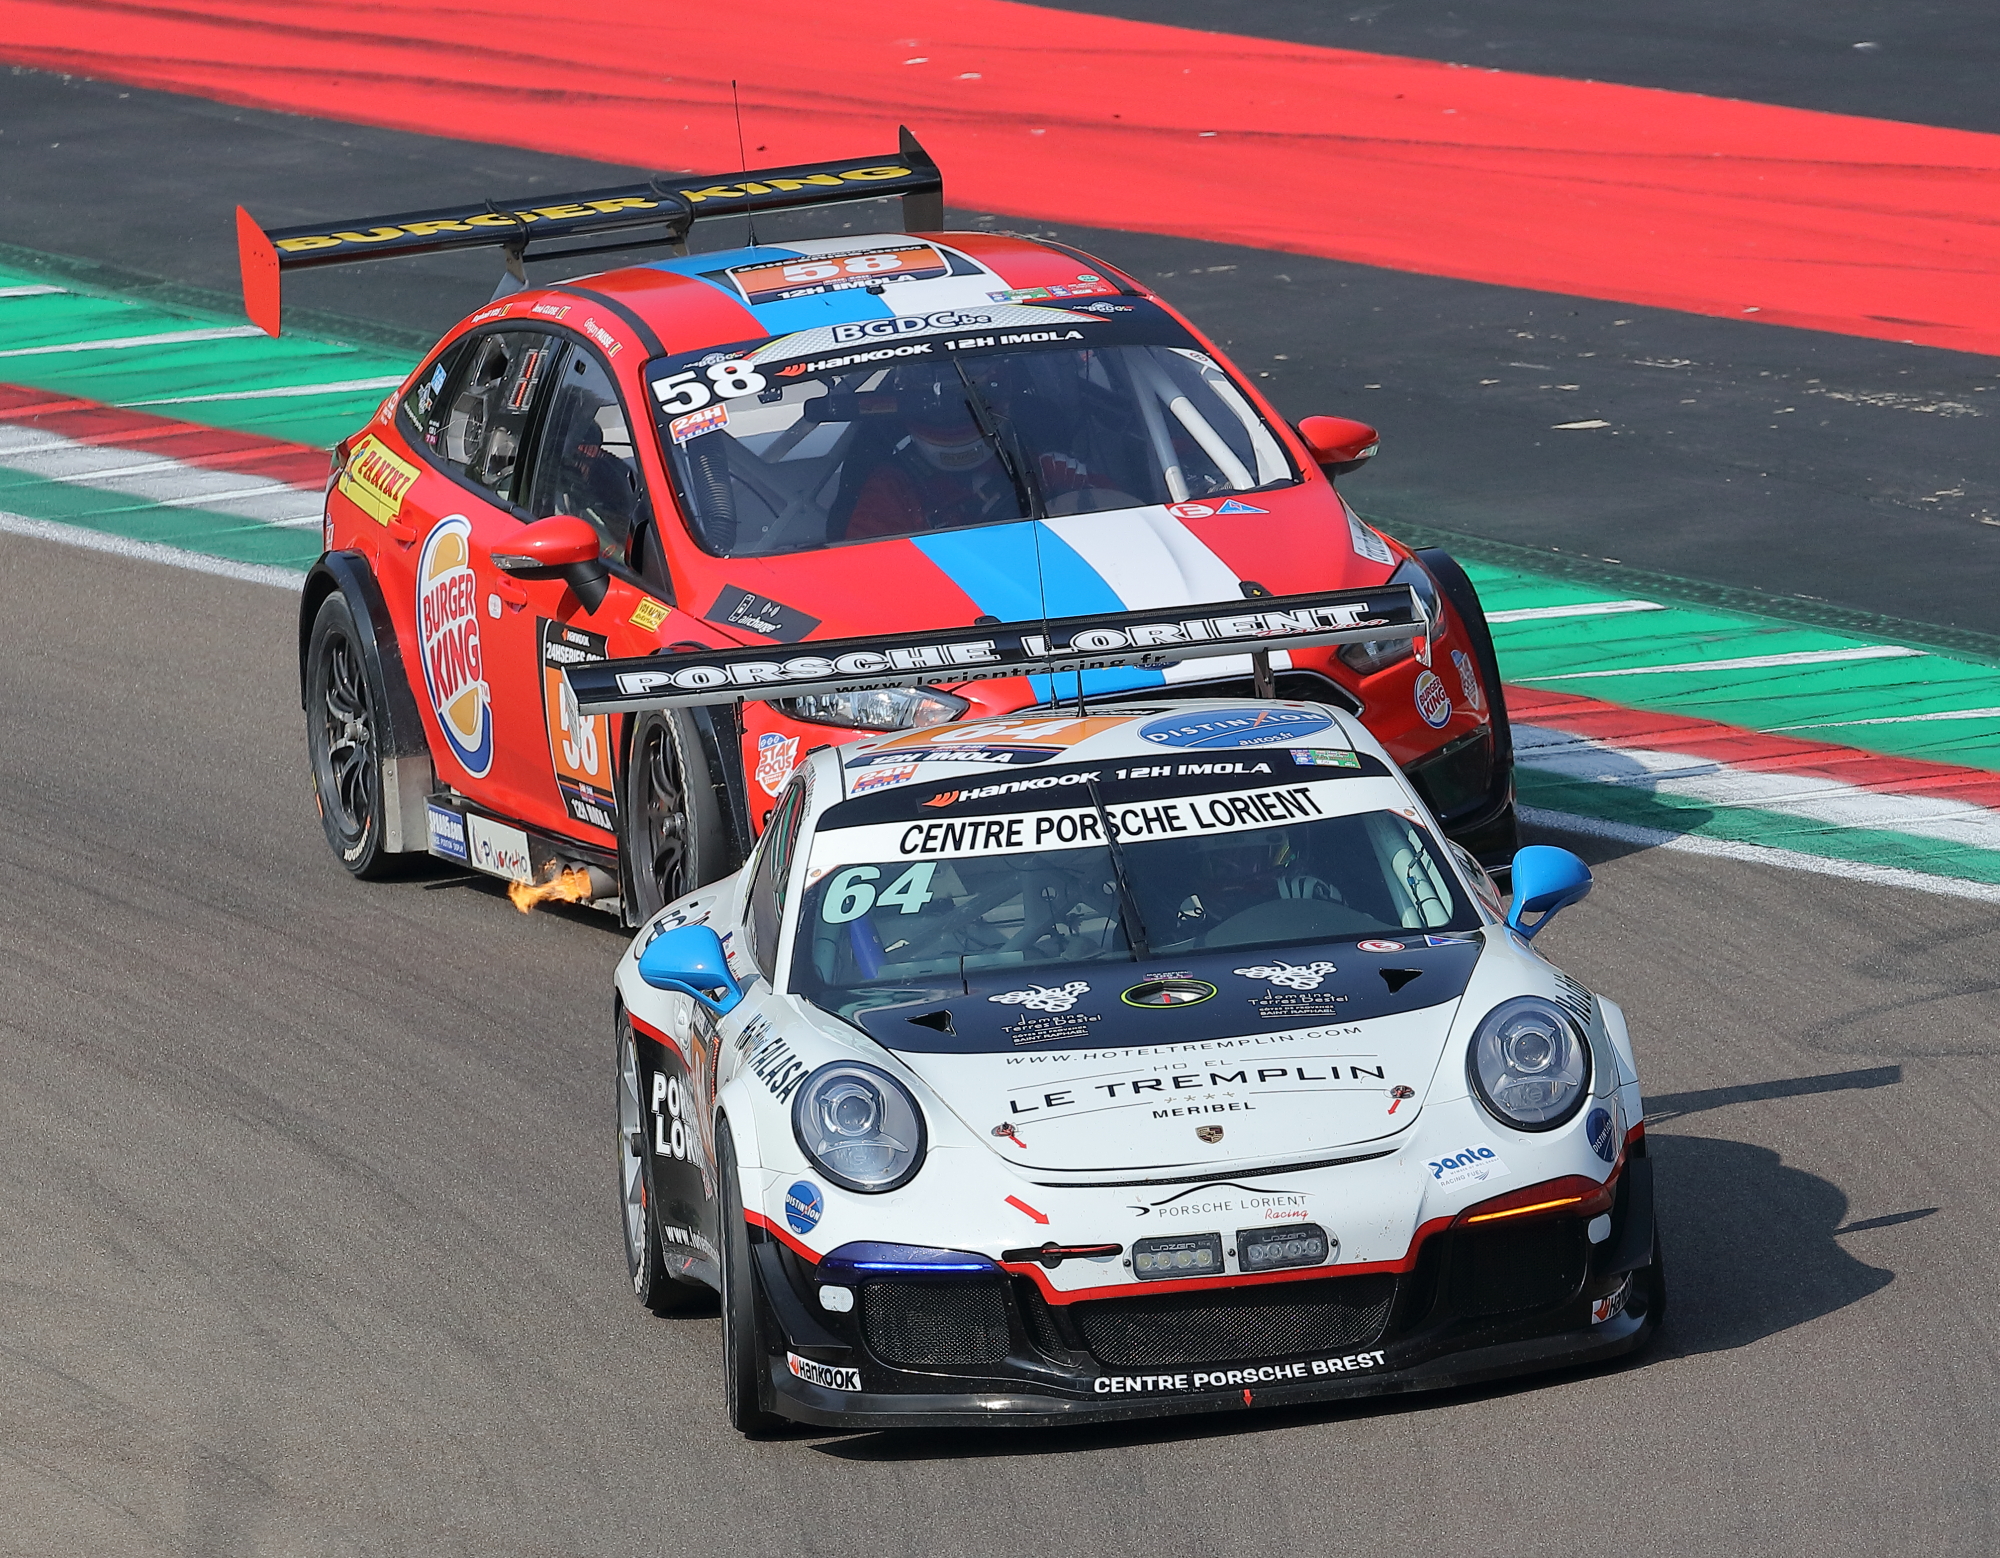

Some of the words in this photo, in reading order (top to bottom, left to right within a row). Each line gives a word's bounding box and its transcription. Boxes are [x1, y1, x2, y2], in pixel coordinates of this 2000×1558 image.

[276, 197, 658, 251] BURGER
[680, 165, 912, 203] KING
[783, 254, 902, 282] 58
[777, 286, 825, 300] 12H
[832, 274, 916, 290] IMOLA
[833, 311, 992, 343] BGDC.be
[944, 336, 995, 351] 12H
[1000, 330, 1085, 346] IMOLA
[651, 359, 767, 415] 58
[674, 406, 723, 430] 24H
[357, 450, 411, 502] PANINI
[423, 573, 475, 644] BURGER
[614, 640, 1002, 695] PORSCHE
[1020, 602, 1370, 658] LORIENT
[430, 618, 481, 709] KING
[1424, 686, 1447, 719] KING
[930, 718, 1090, 743] 64
[1146, 709, 1323, 743] DISTINXION
[1239, 731, 1295, 747] autos.fr
[761, 740, 796, 765] STAY
[870, 753, 917, 766] 12H
[921, 750, 1015, 764] IMOLA
[757, 755, 793, 779] FOCUS
[859, 765, 915, 783] 24H
[1115, 764, 1171, 781] 12H
[1177, 762, 1273, 776] IMOLA
[899, 819, 1025, 856] CENTRE
[1035, 803, 1188, 845] PORSCHE
[1188, 787, 1324, 830] LORIENT
[821, 862, 939, 925] 64
[1247, 998, 1297, 1006] Terres
[1264, 989, 1332, 1000] domaine
[1001, 1022, 1051, 1033] Terres
[1017, 1013, 1085, 1026] domaine
[1005, 1025, 1363, 1066] WWW.HOTELTREMPLIN.COM
[1010, 1090, 1075, 1114] LE
[1095, 1065, 1385, 1099] TREMPLIN
[1152, 1101, 1256, 1118] MERIBEL
[1428, 1147, 1496, 1179] panta
[1441, 1175, 1466, 1187] RACING
[1467, 1169, 1484, 1178] FUEL
[785, 1193, 821, 1221] DISTINXION
[1159, 1201, 1234, 1218] PORSCHE
[1241, 1195, 1307, 1210] LORIENT
[1264, 1207, 1309, 1221] Racing
[1151, 1242, 1196, 1252] LAZER
[1262, 1232, 1307, 1243] LAZER
[1094, 1374, 1188, 1394] CENTRE
[1194, 1363, 1308, 1388] PORSCHE
[1312, 1350, 1385, 1376] BREST
